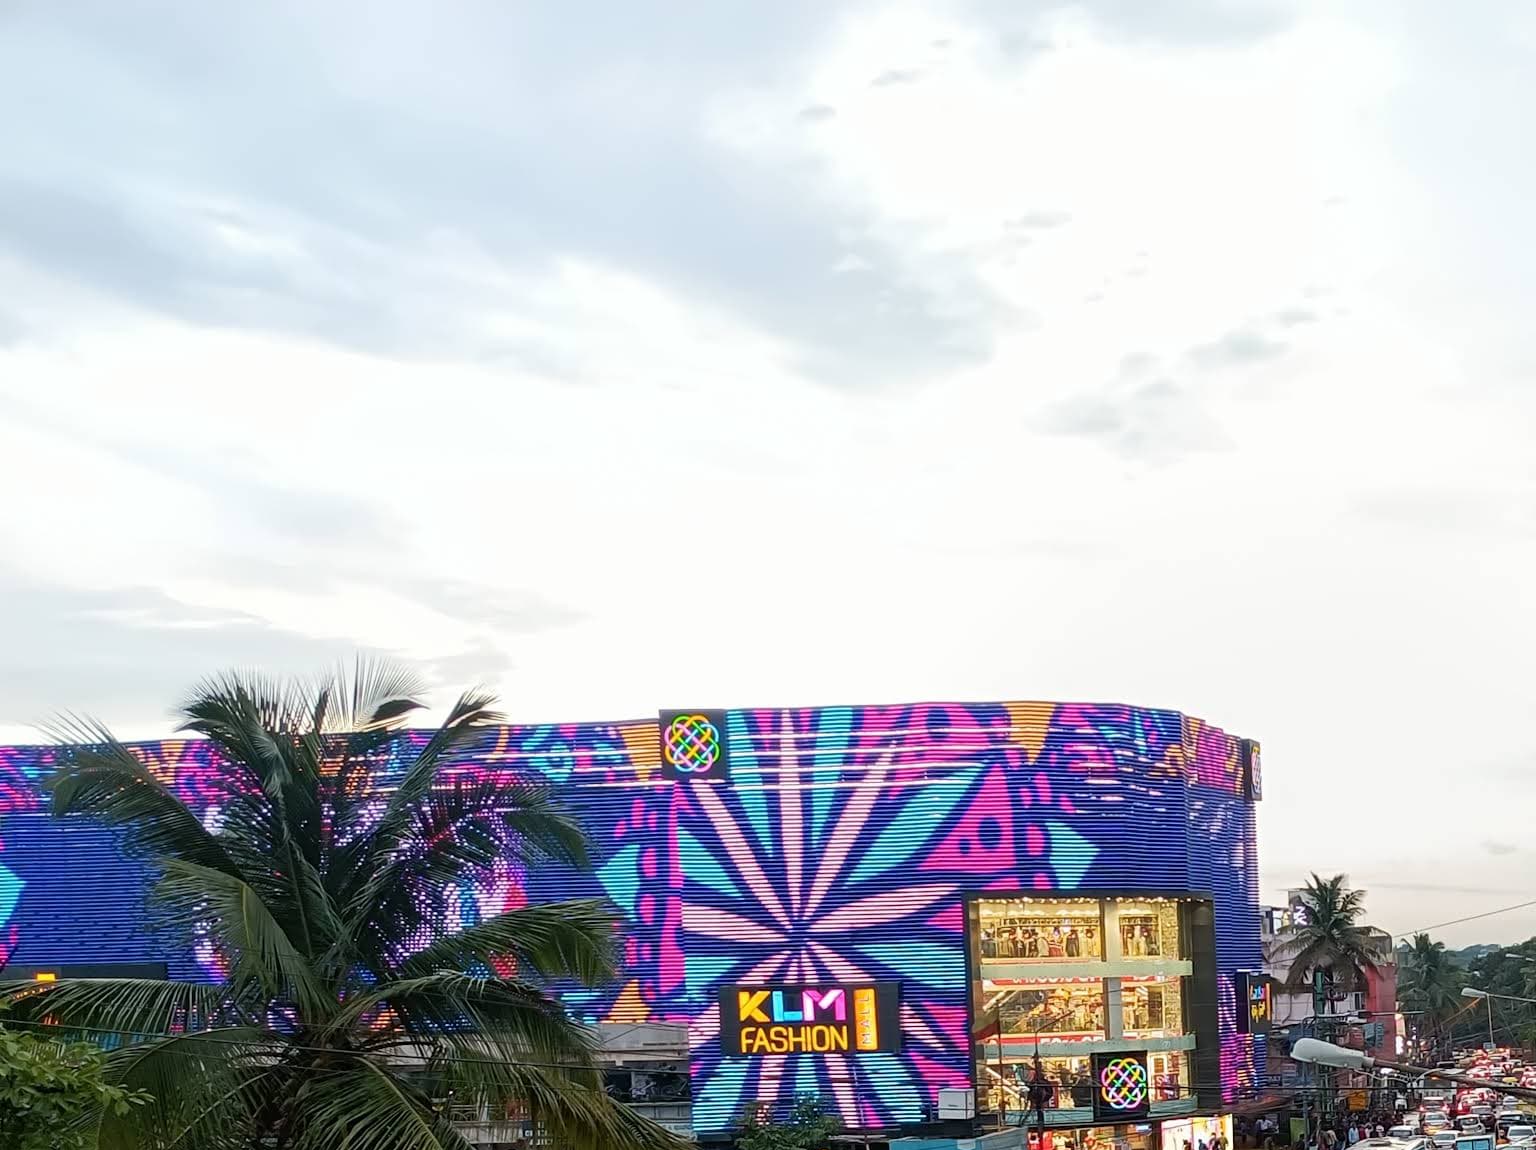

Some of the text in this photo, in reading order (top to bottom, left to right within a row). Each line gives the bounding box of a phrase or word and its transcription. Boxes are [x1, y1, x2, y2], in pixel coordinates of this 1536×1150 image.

[739, 989, 846, 1022] KLM
[862, 994, 871, 1044] MALL
[741, 1025, 848, 1053] FASHION
